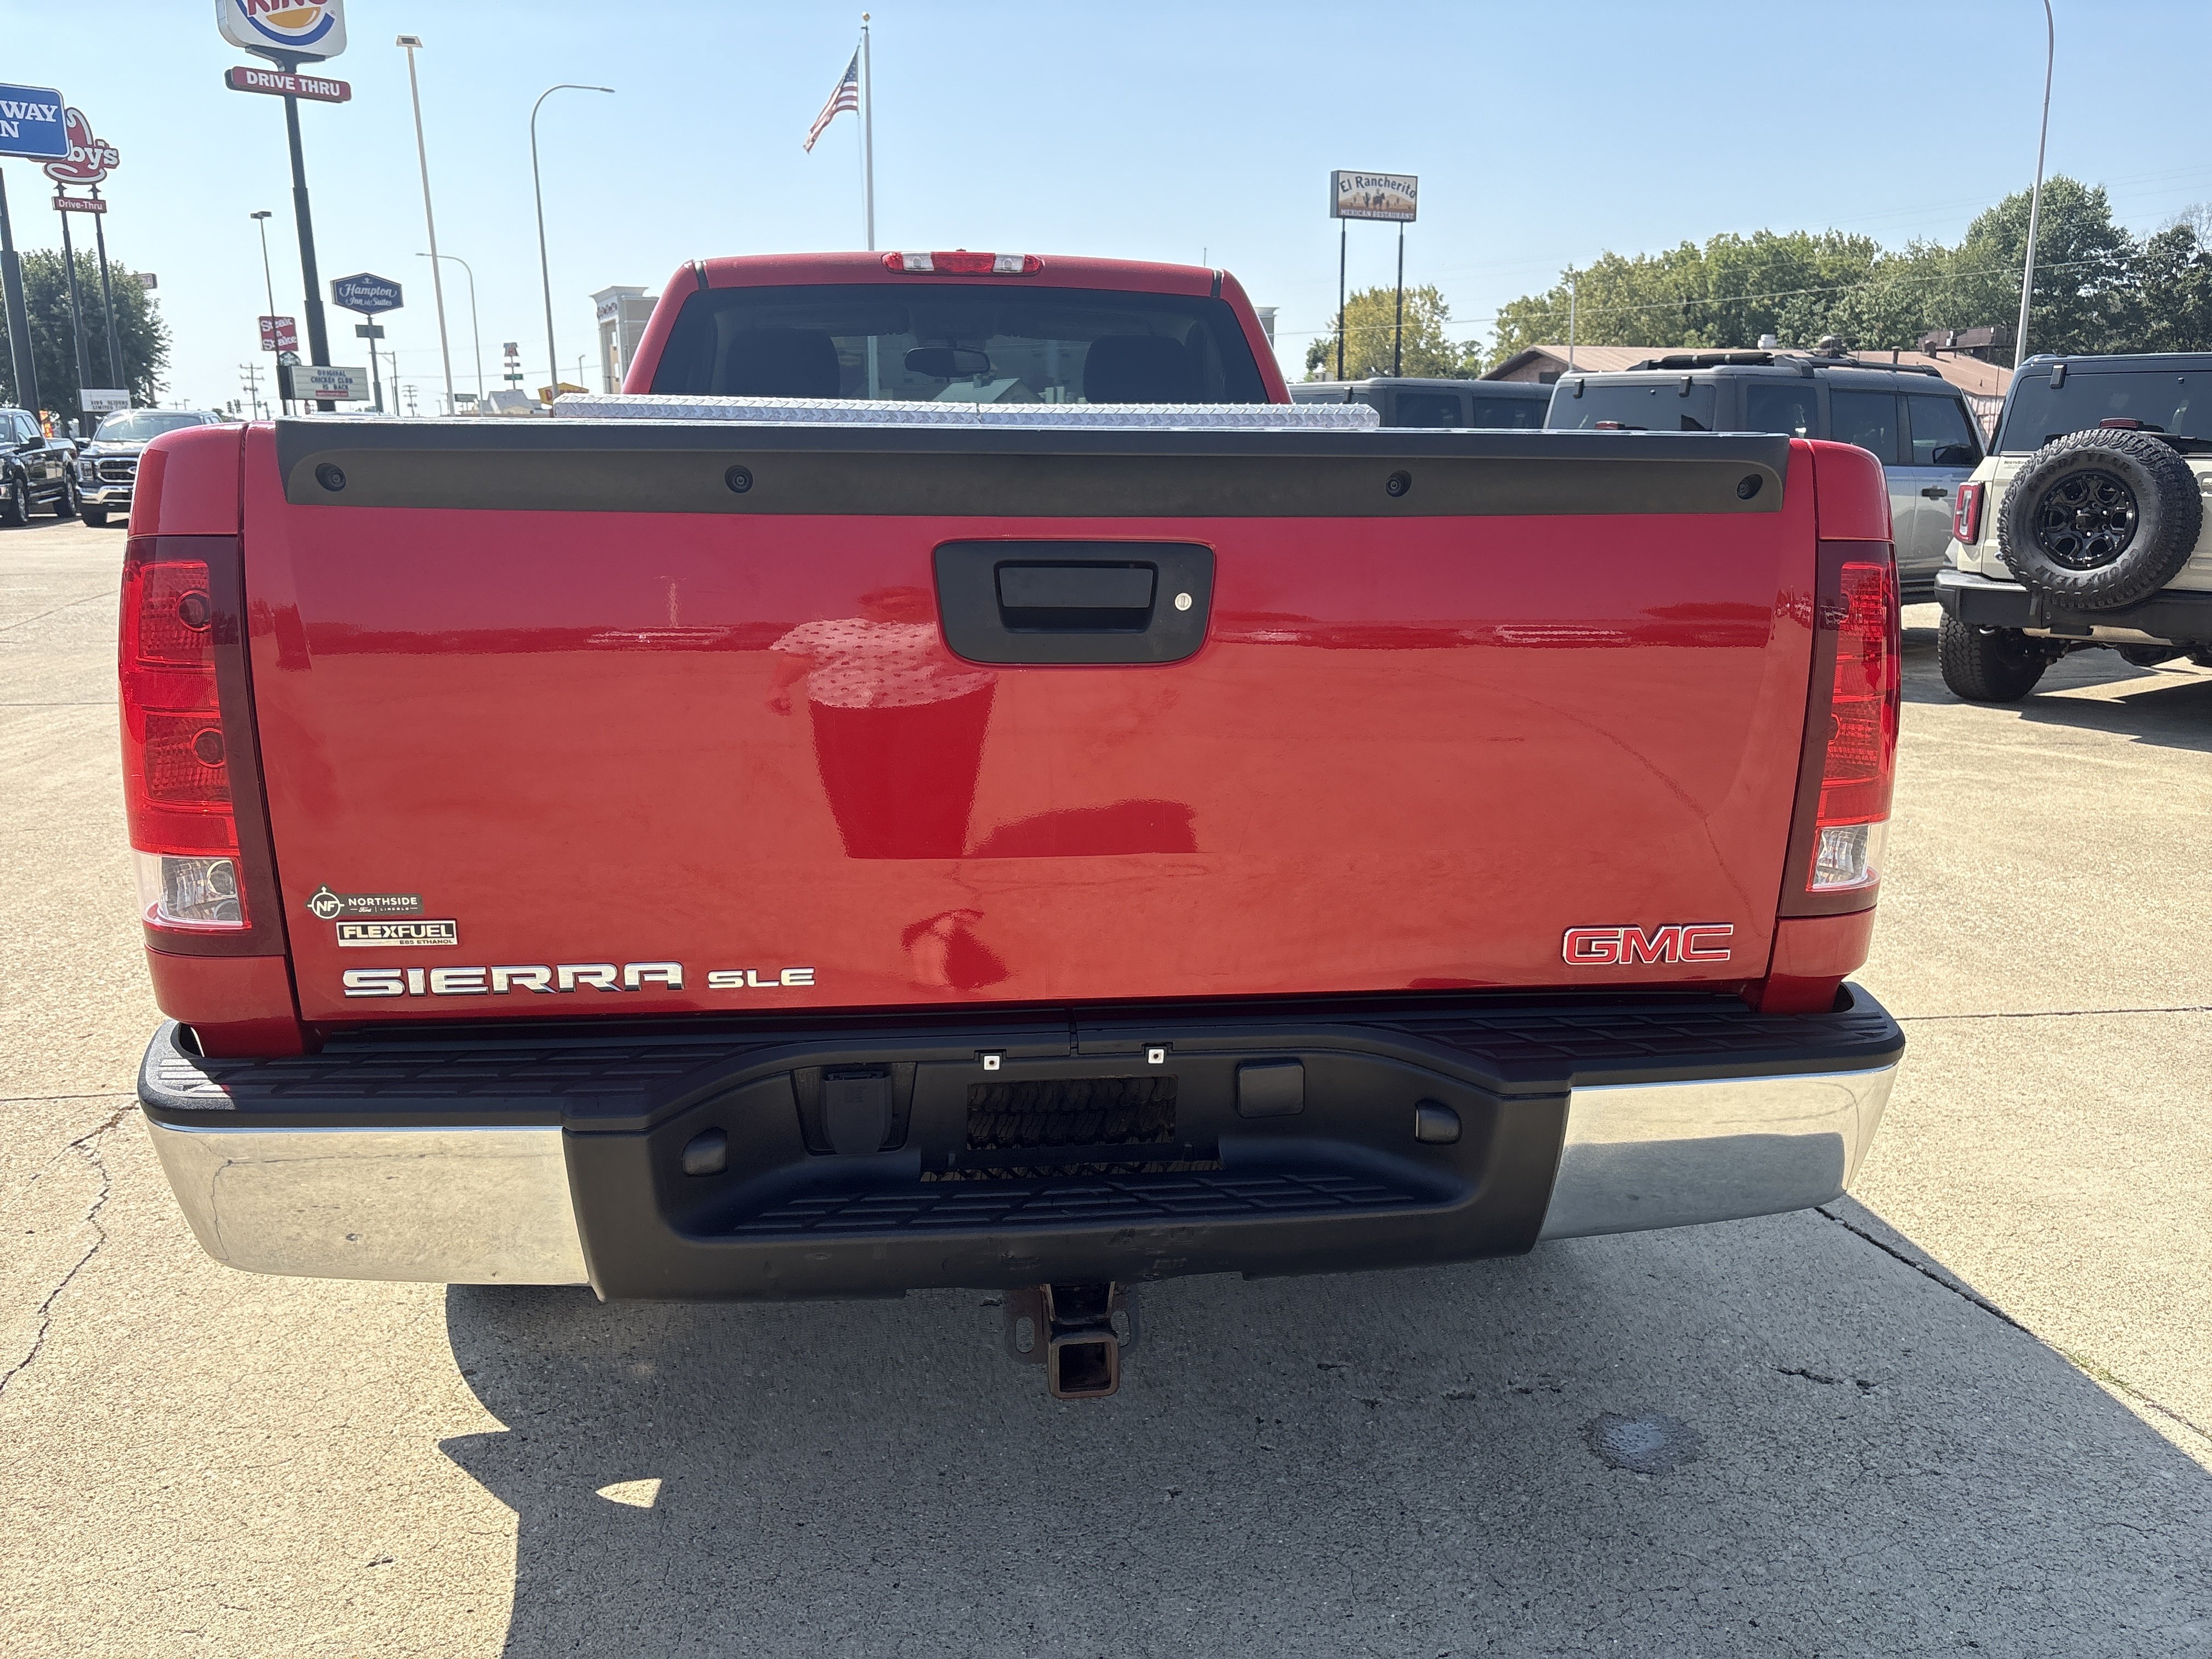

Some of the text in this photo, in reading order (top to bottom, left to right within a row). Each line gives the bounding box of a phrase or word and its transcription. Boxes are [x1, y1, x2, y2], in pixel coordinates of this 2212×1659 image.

[246, 71, 340, 97] DRIVE THRU
[1339, 176, 1417, 199] El Rancherito
[58, 199, 103, 210] Drive-Thru
[339, 283, 398, 298] Hampton
[346, 297, 363, 306] Inn
[371, 297, 393, 307] Suites
[317, 897, 418, 915] NF NORTHSIDE
[343, 925, 453, 939] FLEXFUEL
[1563, 923, 1734, 966] GMC
[342, 961, 815, 998] SIERRA SLE
